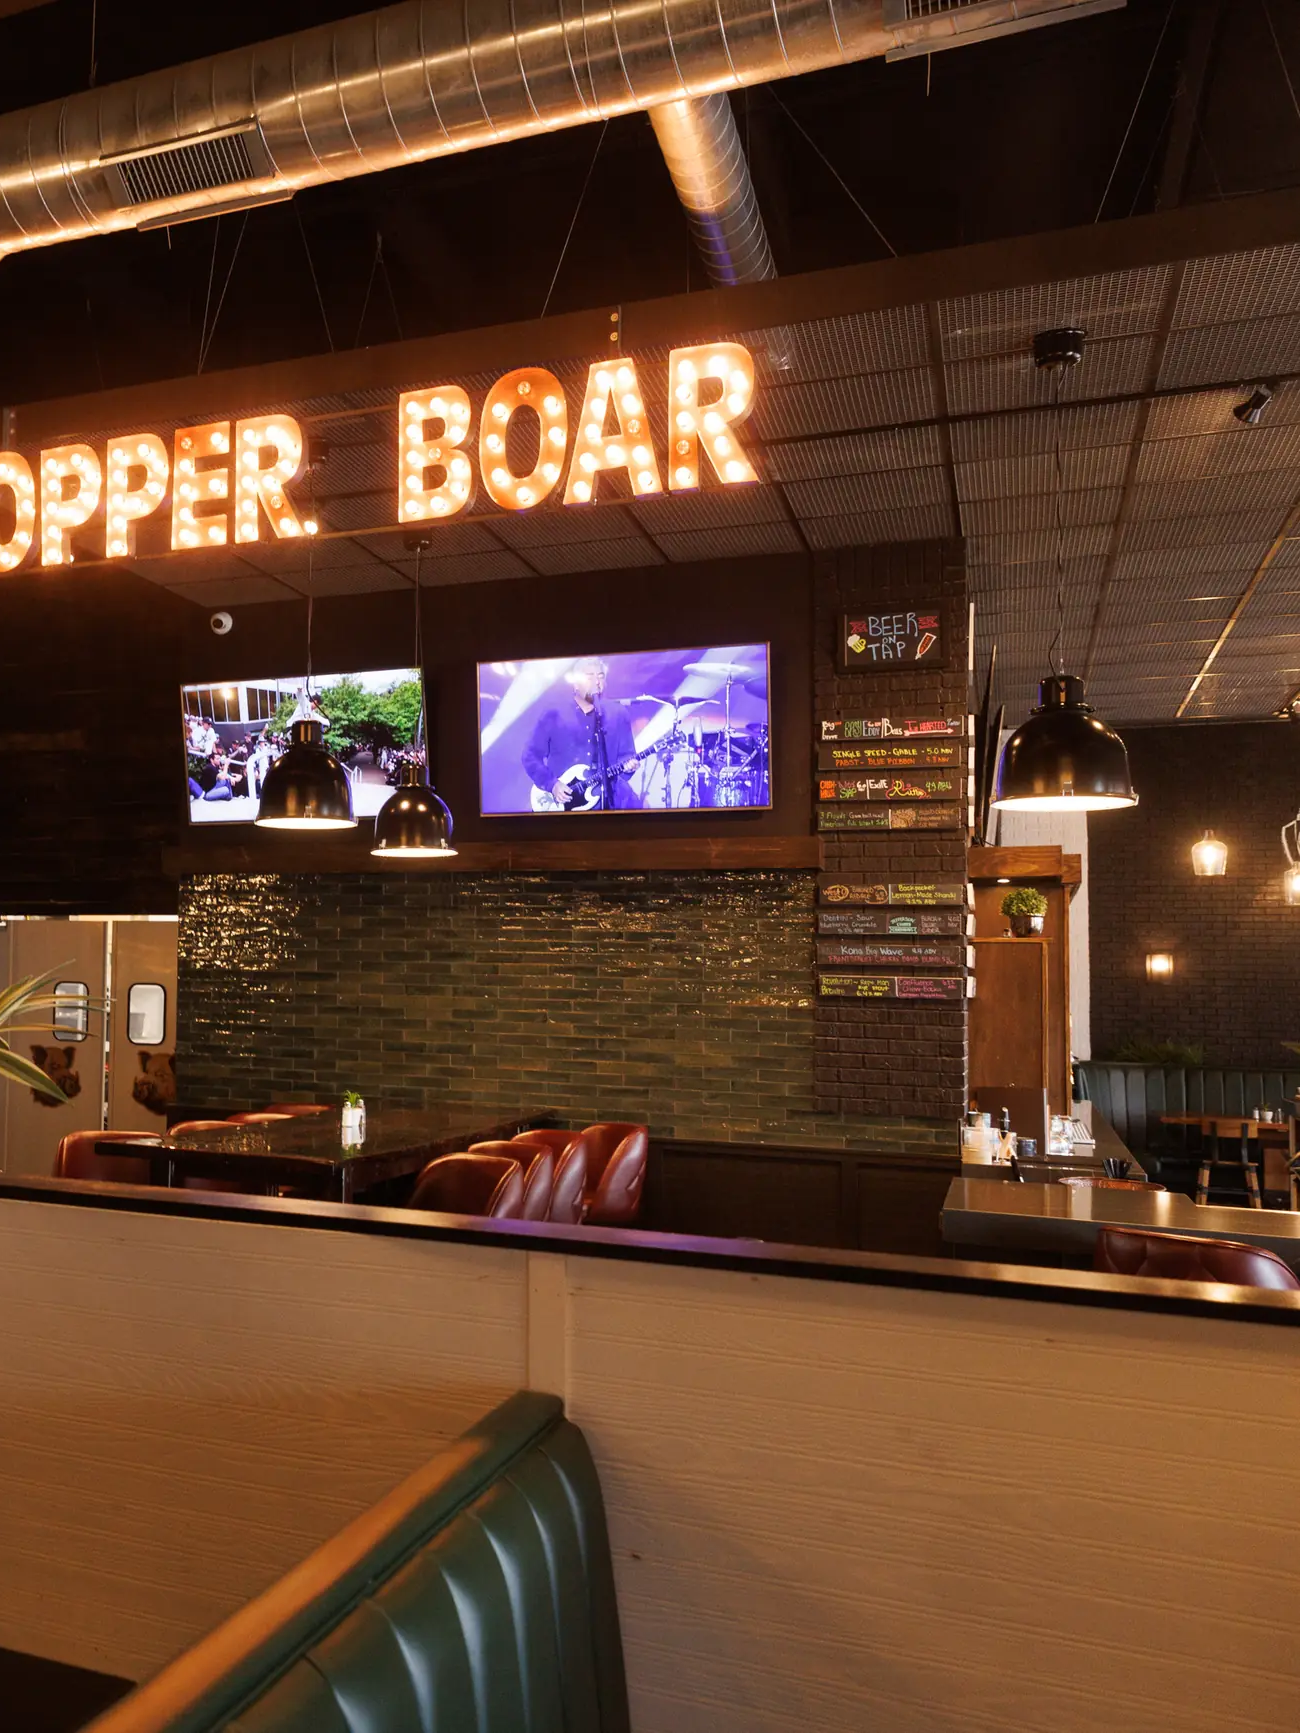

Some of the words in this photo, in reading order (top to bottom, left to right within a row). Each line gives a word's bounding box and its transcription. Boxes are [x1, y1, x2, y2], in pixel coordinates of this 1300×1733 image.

[398, 342, 761, 523] BOAR
[867, 612, 918, 637] BEER
[882, 635, 897, 644] ON
[867, 641, 906, 661] TAP
[832, 750, 861, 758] SINGLE
[864, 749, 887, 757] SPEED
[892, 748, 918, 756] GABLE
[835, 759, 859, 767] PABST
[840, 945, 863, 955] Kona
[879, 947, 904, 955] Wave
